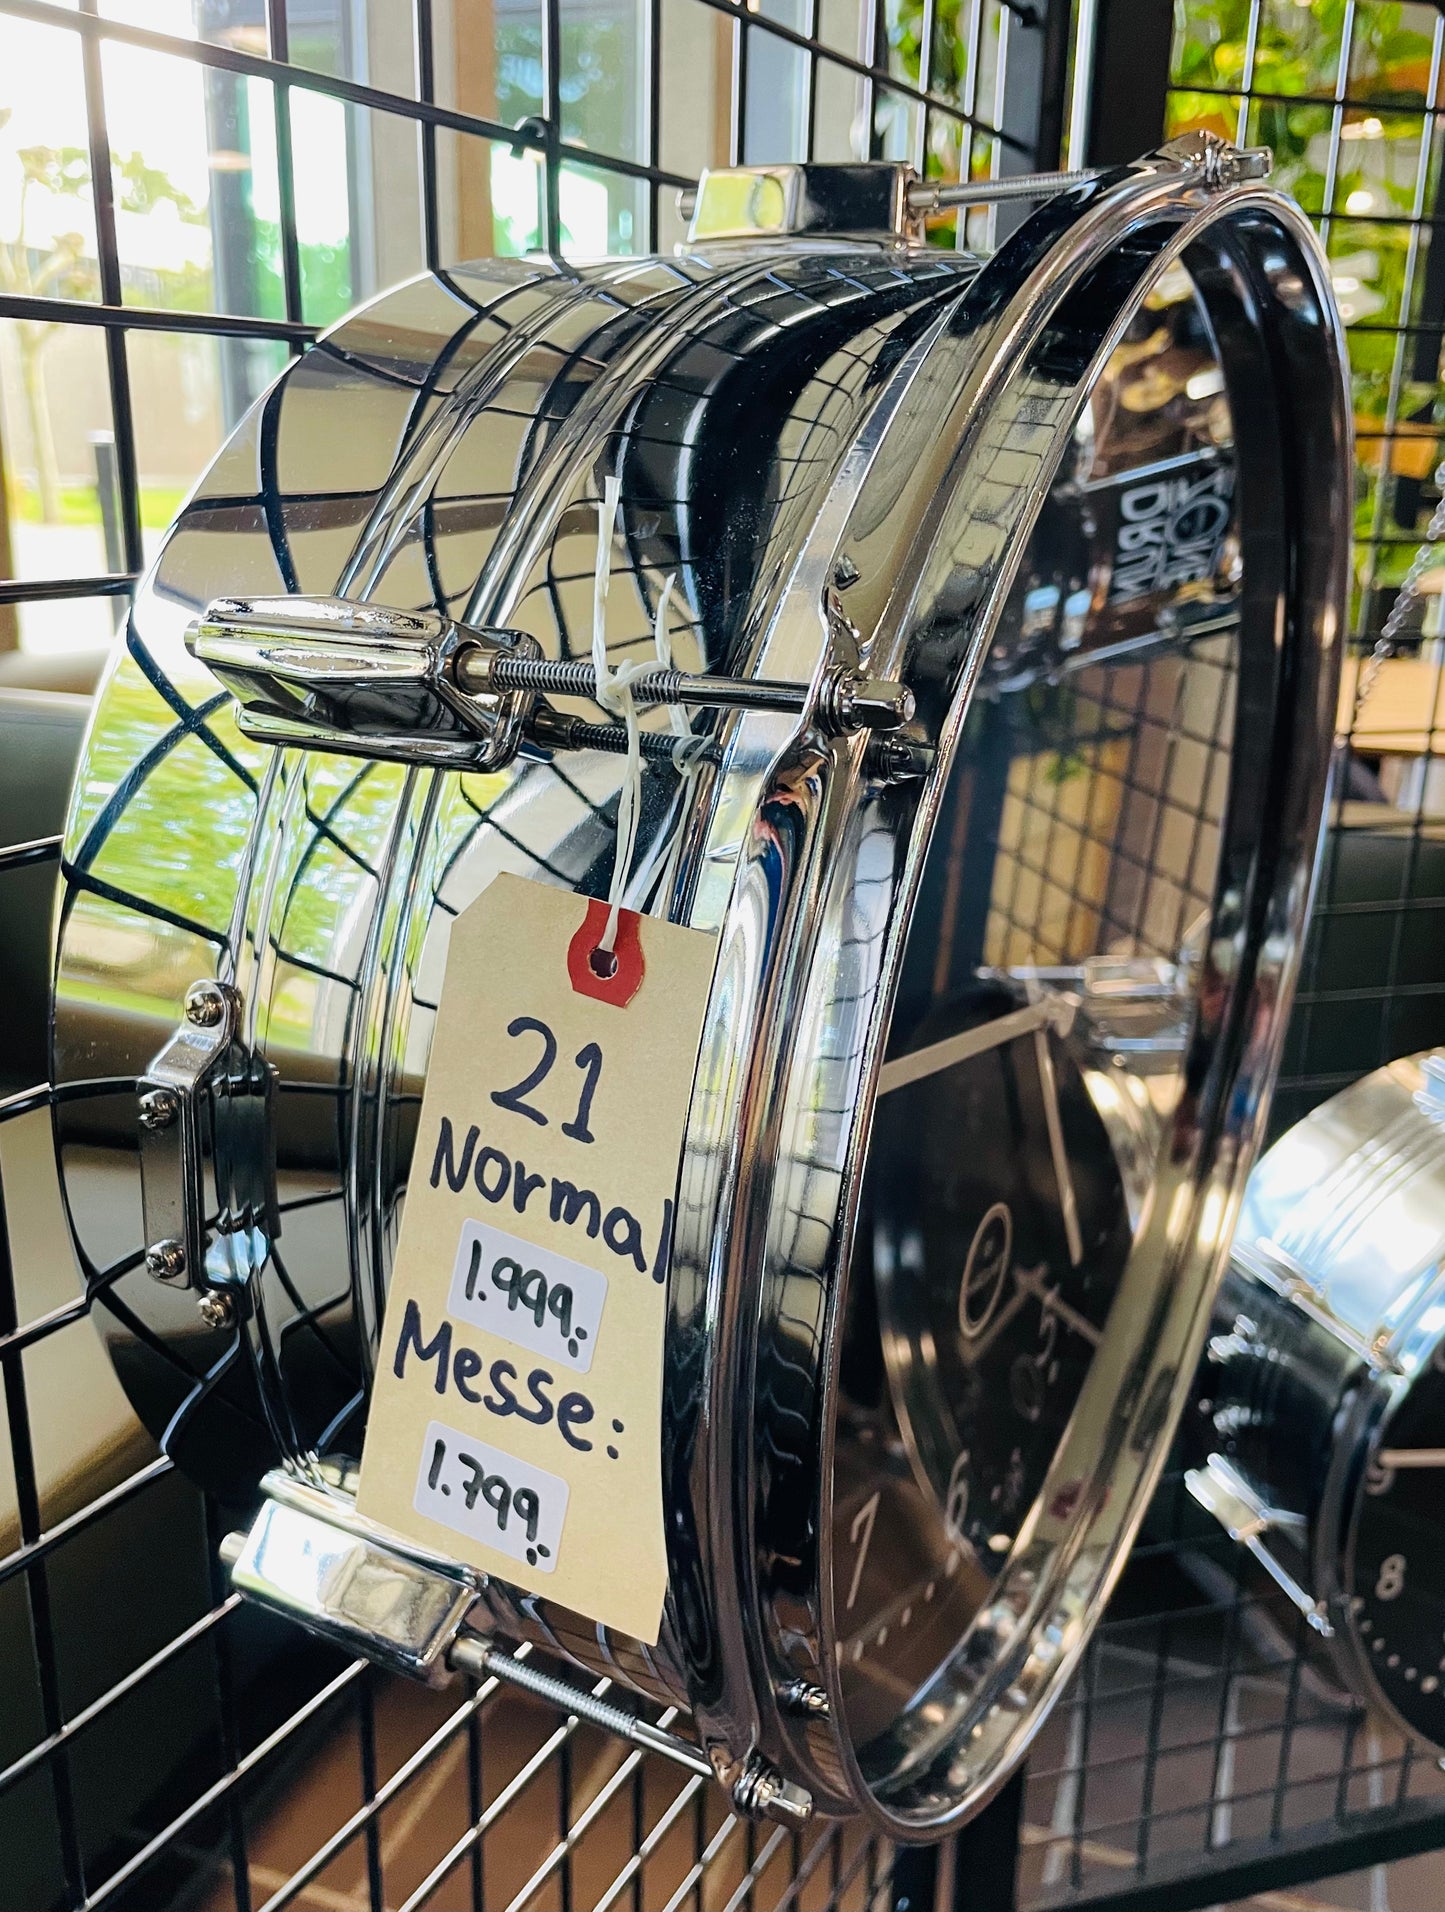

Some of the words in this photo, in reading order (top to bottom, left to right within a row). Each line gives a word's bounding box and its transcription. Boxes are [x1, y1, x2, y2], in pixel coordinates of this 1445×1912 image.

[490, 1016, 603, 1144] 21
[429, 1116, 673, 1285] Normal
[393, 1299, 625, 1460] Messe:
[1376, 1554, 1407, 1601] 8
